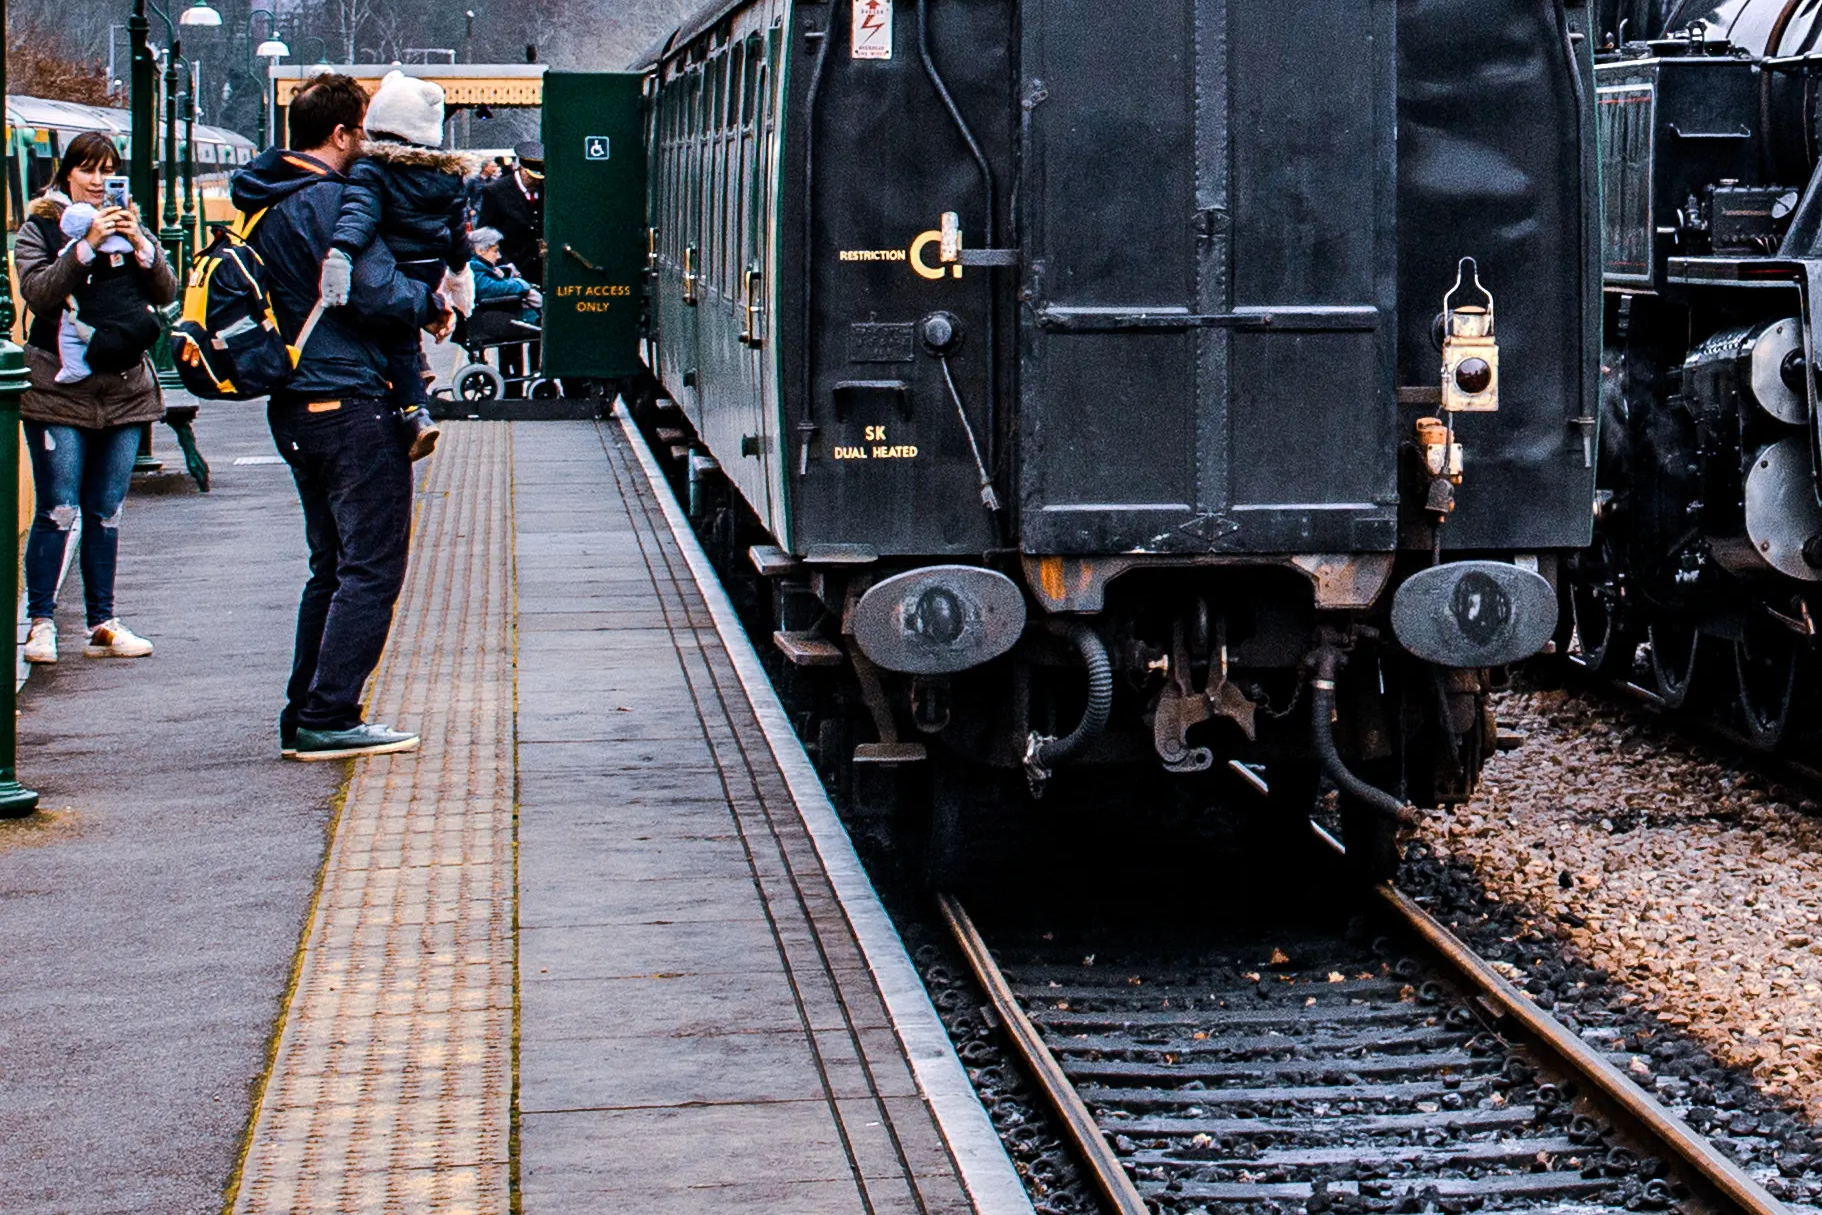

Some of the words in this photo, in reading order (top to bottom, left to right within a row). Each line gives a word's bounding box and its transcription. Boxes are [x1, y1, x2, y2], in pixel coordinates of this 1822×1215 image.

[839, 249, 906, 261] RESTRICTION
[556, 285, 582, 297] LIFT
[585, 285, 631, 296] ACCESS
[576, 301, 609, 312] ONLY
[864, 425, 887, 441] SK
[834, 446, 868, 460] DUAL
[872, 445, 919, 459] HEATED
